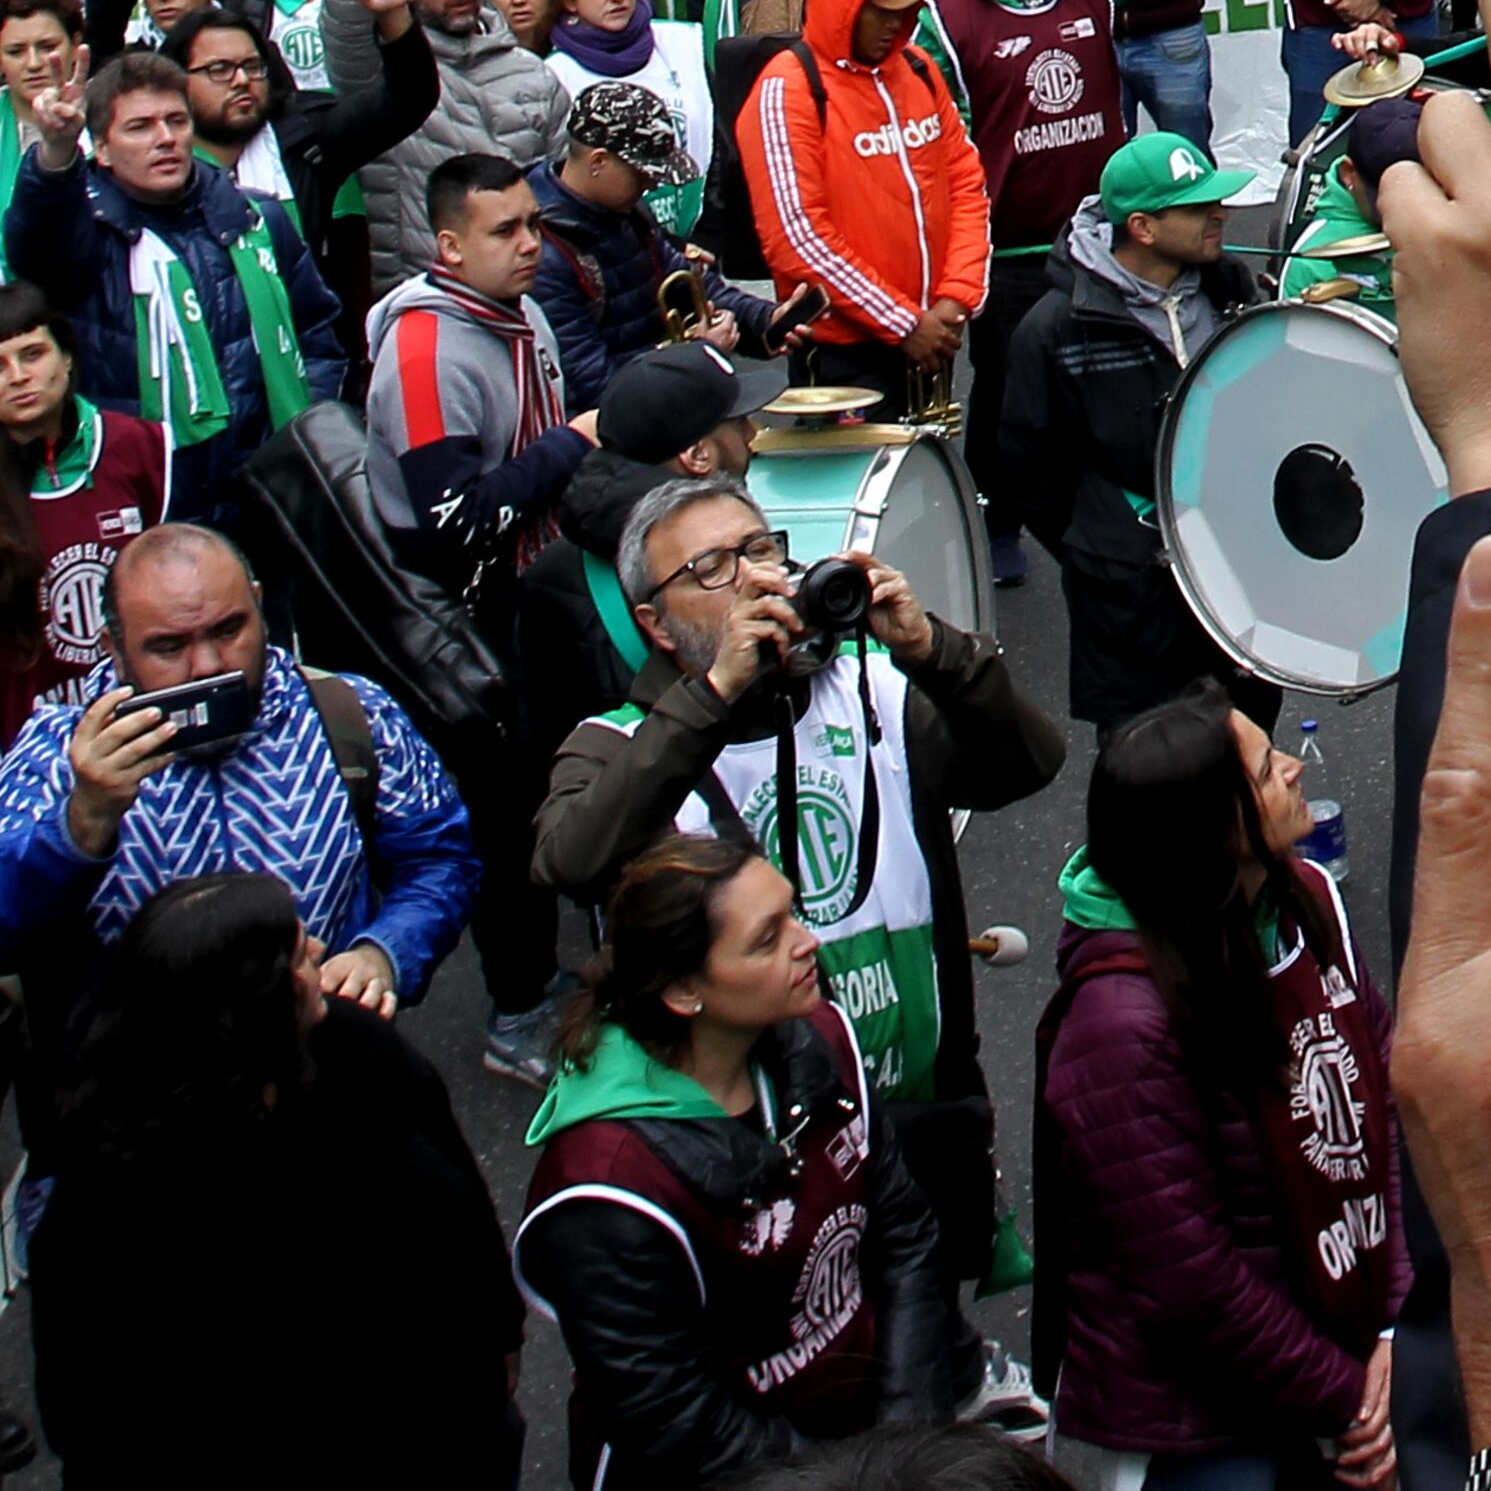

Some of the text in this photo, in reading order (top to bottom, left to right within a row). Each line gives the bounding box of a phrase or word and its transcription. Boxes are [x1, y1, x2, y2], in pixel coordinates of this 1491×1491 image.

[1039, 66, 1071, 100] ATE
[853, 113, 942, 160] adidas
[1013, 111, 1105, 155] ORGANIZACION
[85, 542, 99, 559] EL
[798, 765, 851, 808] EL ESTA
[1317, 1012, 1337, 1037] EL
